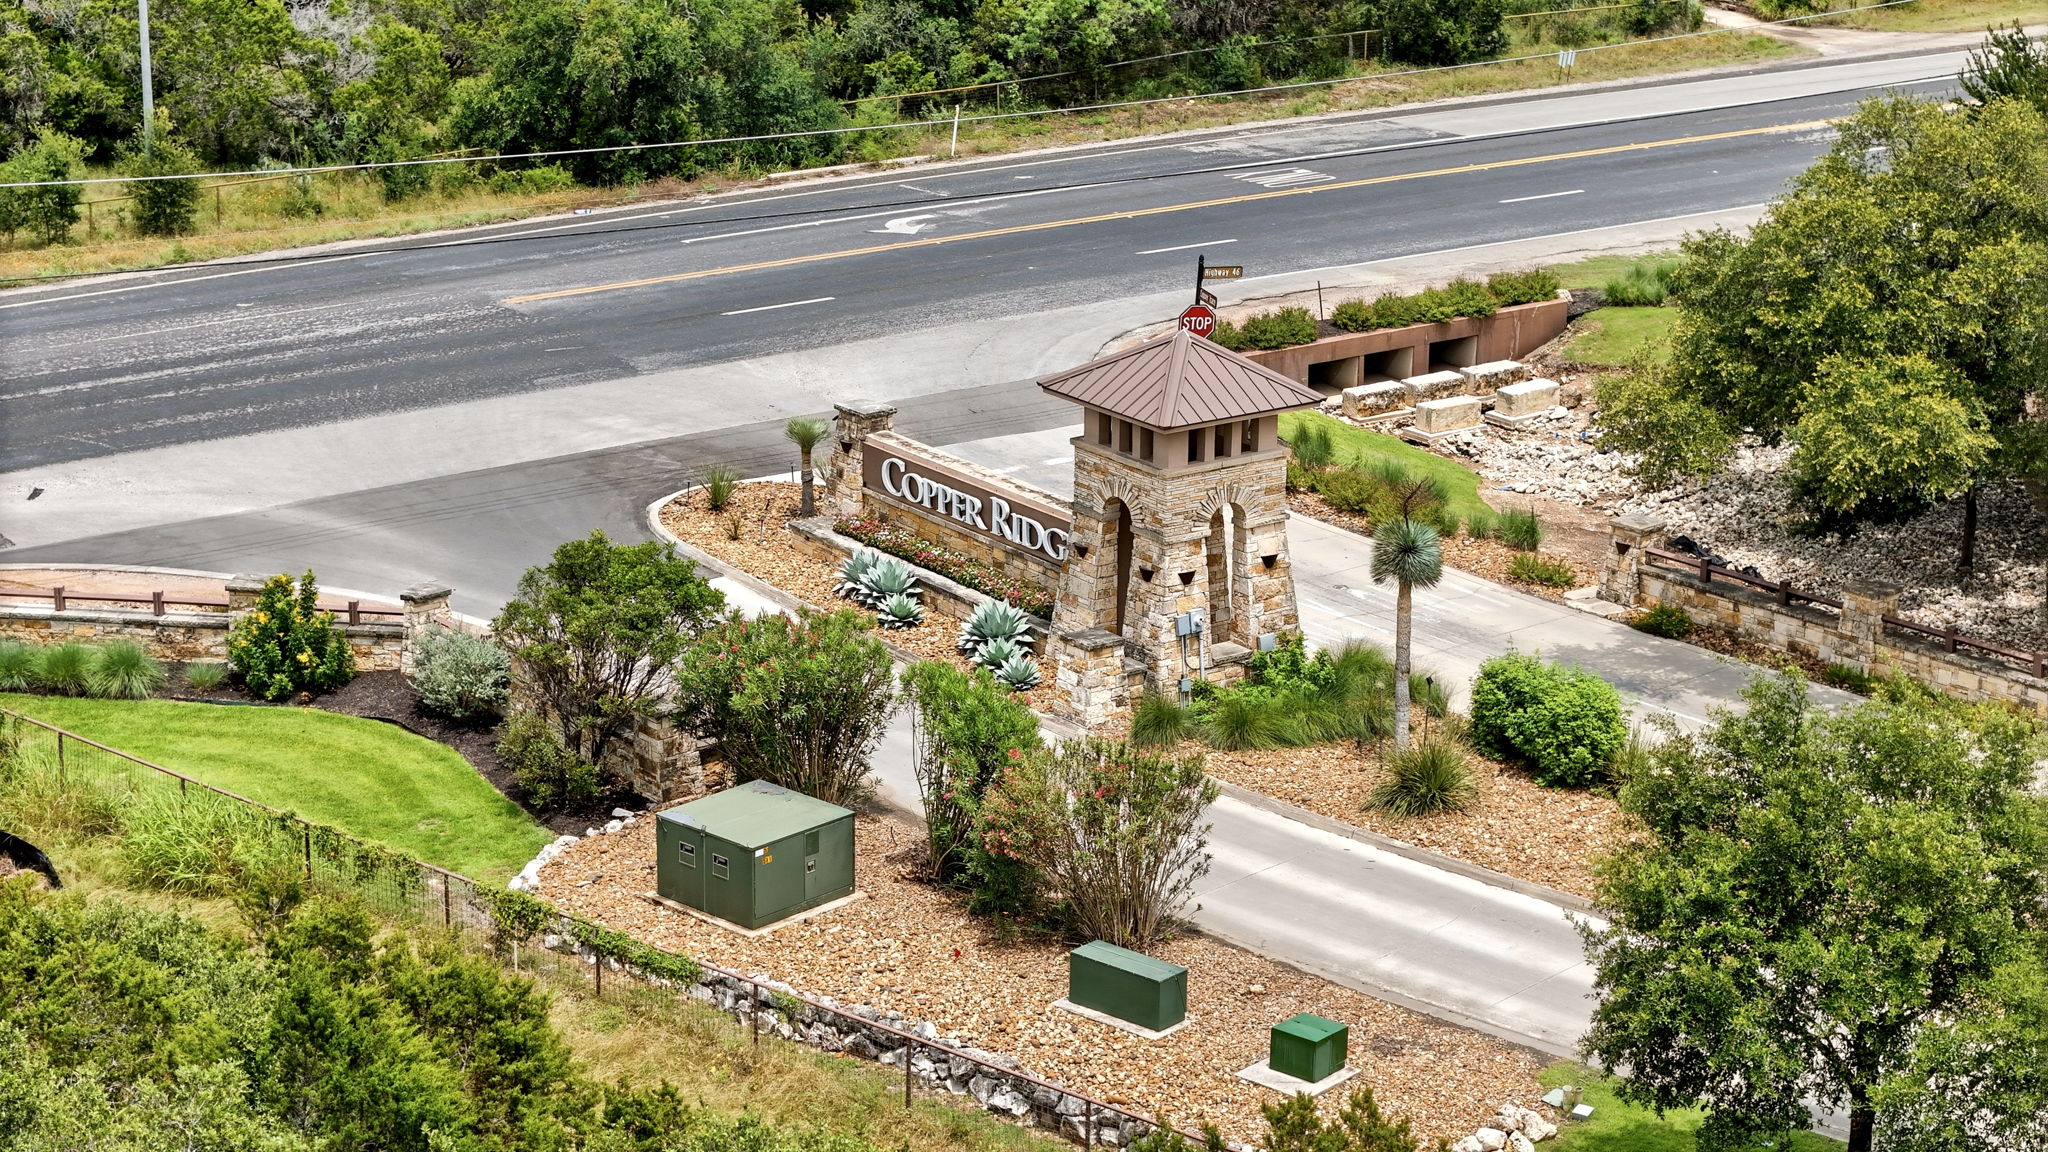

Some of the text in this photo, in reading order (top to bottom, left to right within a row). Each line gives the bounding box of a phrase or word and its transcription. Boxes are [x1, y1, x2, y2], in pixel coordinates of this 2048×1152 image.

[1204, 267, 1241, 277] Highway 46
[1183, 317, 1212, 330] STOP
[881, 457, 1069, 562] COPPER RIDG
